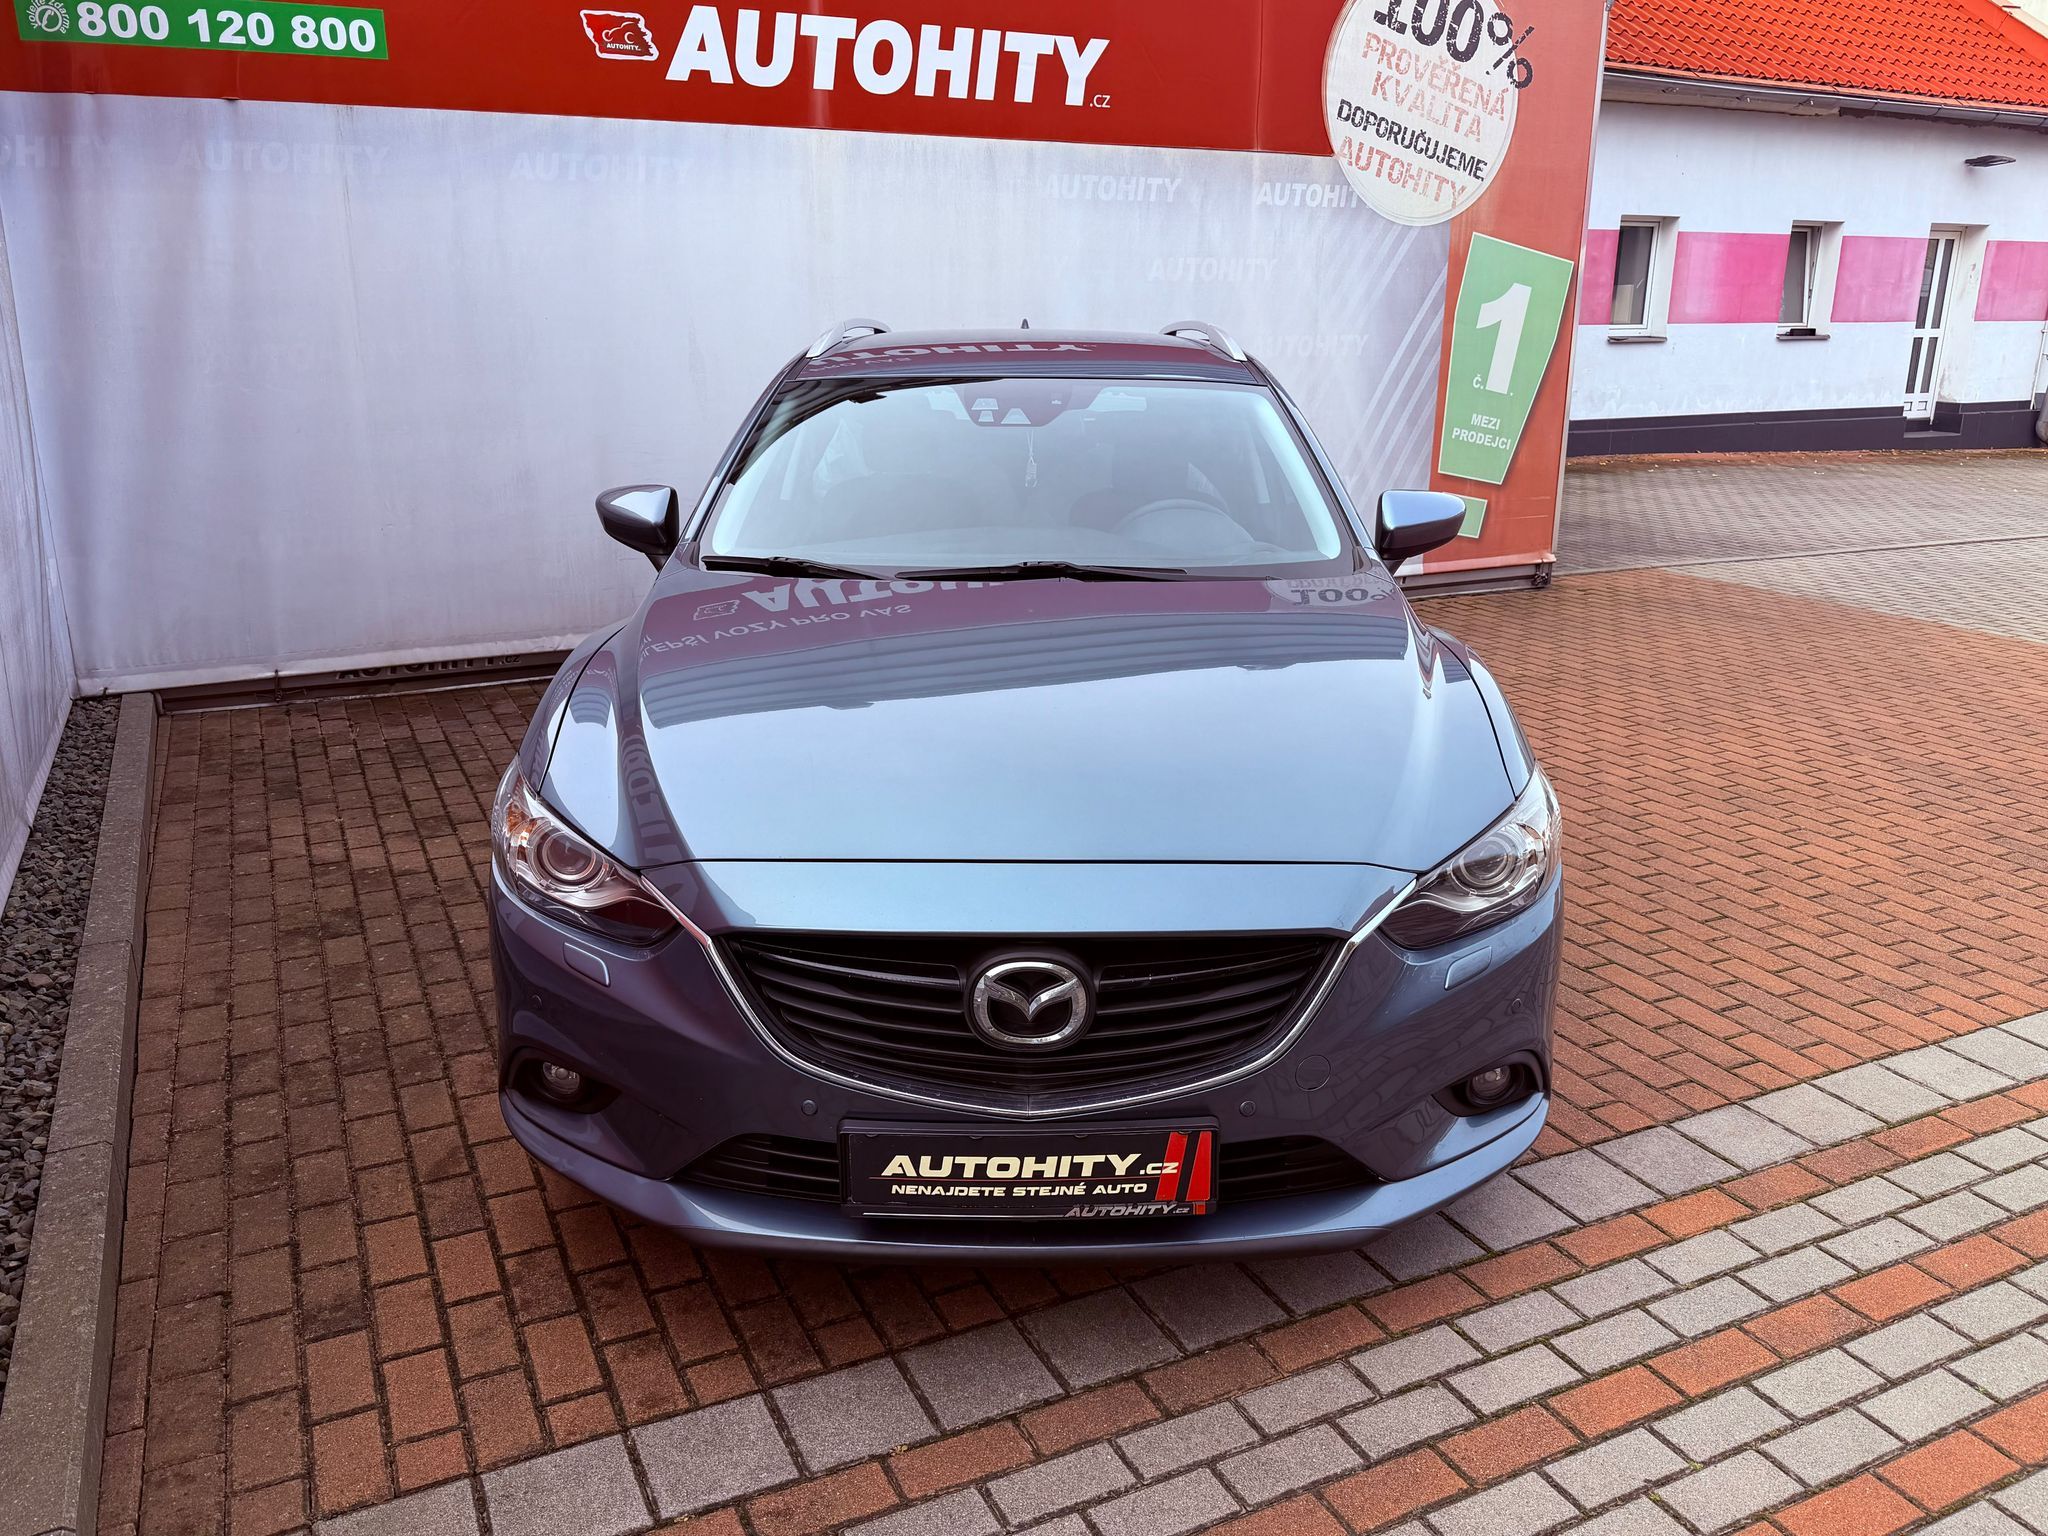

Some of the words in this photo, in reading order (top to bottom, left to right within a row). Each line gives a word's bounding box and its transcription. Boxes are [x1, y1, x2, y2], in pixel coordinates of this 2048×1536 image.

[77, 1, 169, 40] 800
[187, 8, 275, 46] 120
[290, 15, 377, 53] 800
[1361, 31, 1509, 122] PROVĚŘENÁ
[1371, 71, 1482, 143] KVALITA
[1336, 98, 1488, 182] DOPORUČUJEME
[1046, 173, 1184, 203] AUTOHITY
[1338, 136, 1467, 209] AUTOHITY
[1146, 257, 1279, 282] AUTOHITY
[1452, 427, 1511, 450] PRODEJCI
[1471, 413, 1500, 431] MEZI
[891, 1183, 1006, 1197] NENAJDETE
[1012, 1182, 1085, 1197] STEJNÉ
[1092, 1183, 1148, 1195] AUTO
